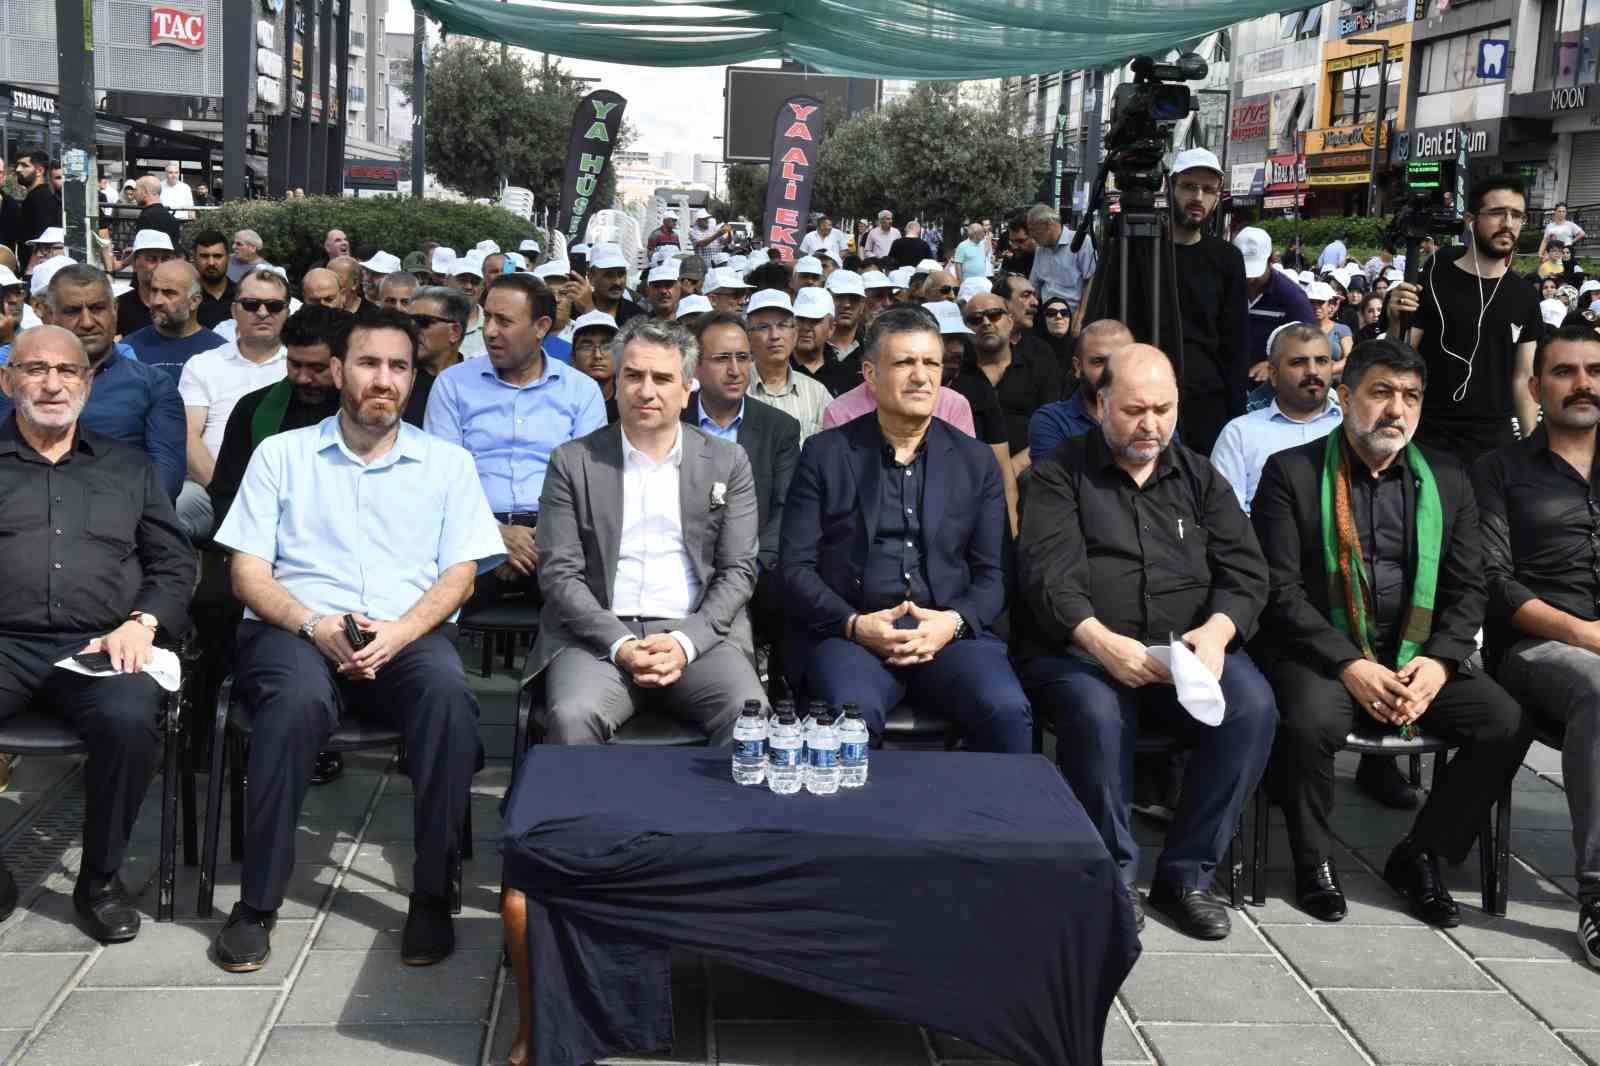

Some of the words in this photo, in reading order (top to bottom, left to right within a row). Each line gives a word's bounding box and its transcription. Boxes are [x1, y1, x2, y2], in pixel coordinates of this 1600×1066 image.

[13, 90, 55, 114] STARBUCKS
[1550, 87, 1585, 112] MOON
[584, 99, 618, 142] YA
[784, 102, 818, 141] YA
[1416, 132, 1443, 158] Dent
